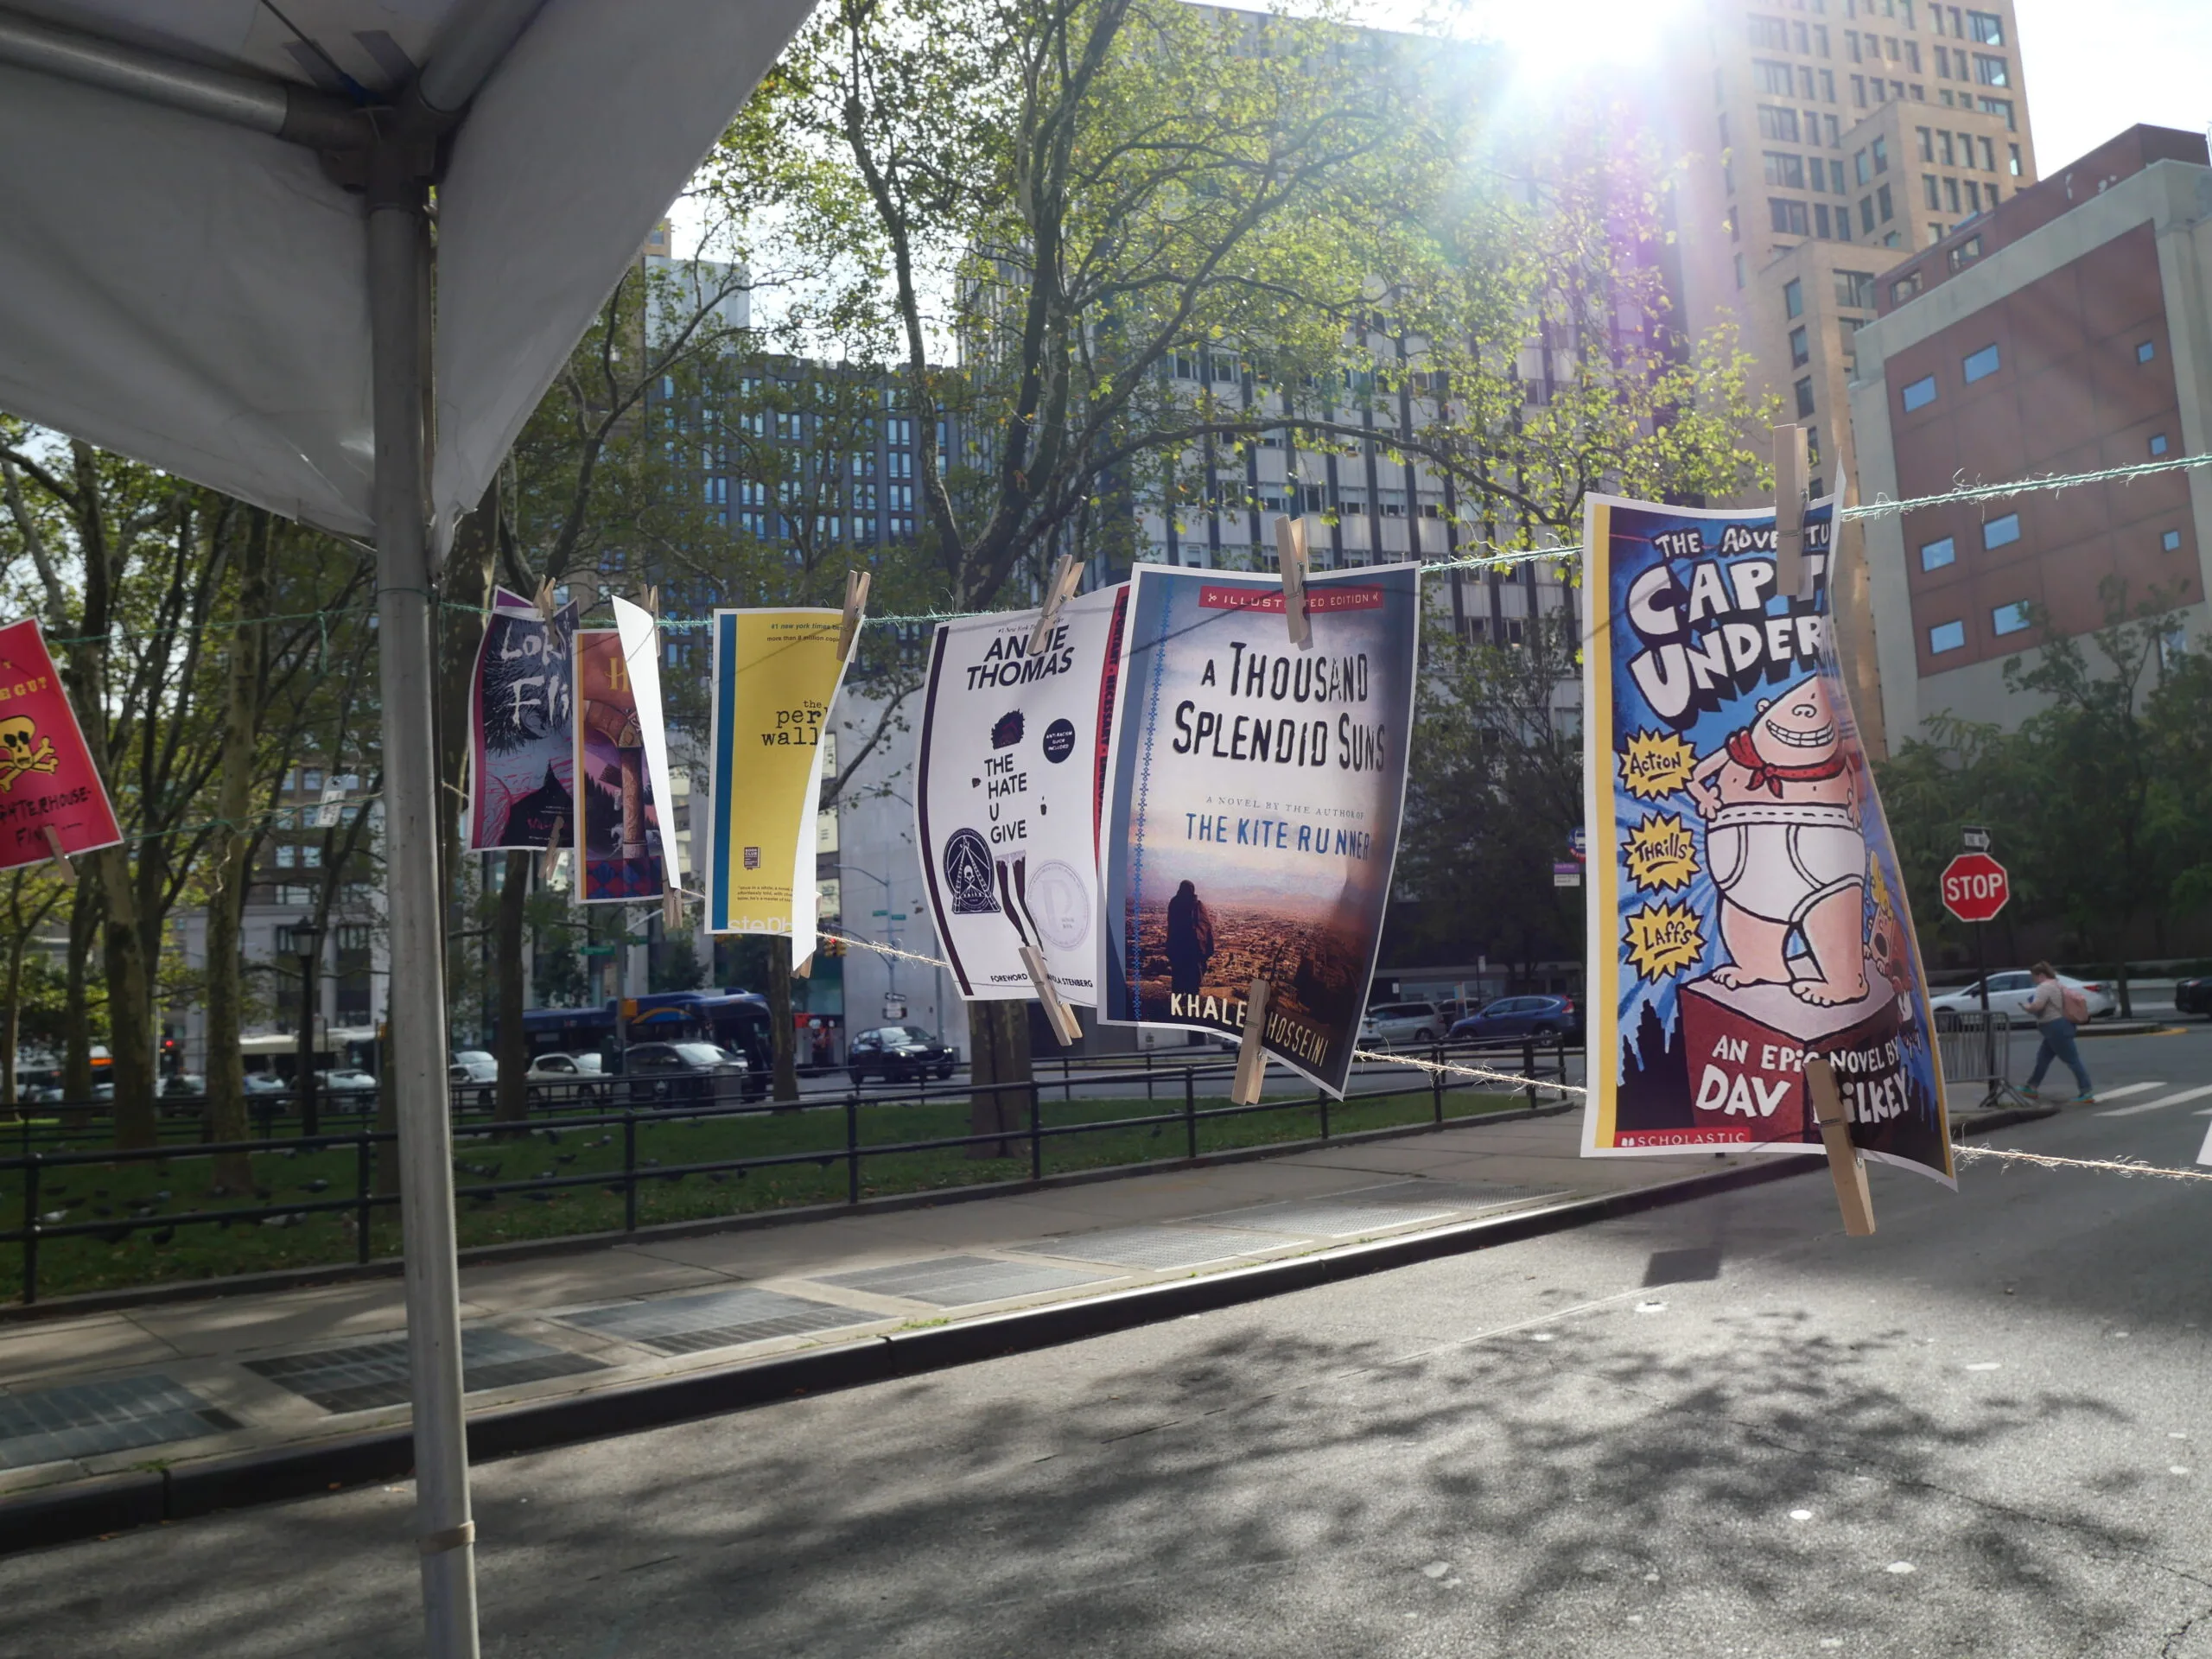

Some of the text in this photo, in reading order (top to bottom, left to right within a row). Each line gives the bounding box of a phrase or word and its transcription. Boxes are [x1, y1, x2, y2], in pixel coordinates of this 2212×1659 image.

[1654, 523, 1830, 558] THE ADVETU
[1224, 594, 1370, 607] ILLUSTED EDITION
[983, 624, 1070, 663] ANIE
[967, 646, 1075, 691] THOMAS
[1201, 641, 1368, 703] A THOUSAND
[776, 708, 829, 729] per
[804, 700, 822, 709] the
[1173, 700, 1384, 772] SPLENDID SUNS
[984, 753, 1014, 778] THE
[988, 772, 1027, 800] HATE
[989, 802, 1000, 822] U
[1218, 796, 1261, 809] NOVEL
[1266, 801, 1280, 810] BY
[1286, 804, 1311, 814] THE
[1315, 808, 1356, 818] AUTHOR
[1356, 810, 1364, 820] OF
[990, 819, 1027, 844] GIVE
[1185, 812, 1370, 861] THE KITE RUNNER
[1947, 873, 2004, 901] STOP
[990, 973, 1028, 982] FOREWORD
[1061, 977, 1094, 988] STENBERG
[1171, 992, 1329, 1068] KHALE HOSSEINI
[1712, 1035, 1749, 1065] AN
[1829, 1046, 1885, 1075] NOVEL
[1885, 1037, 1901, 1066] BY
[1695, 1063, 1792, 1118] DAV
[1637, 1131, 1746, 1147] SCHOLASTIC
